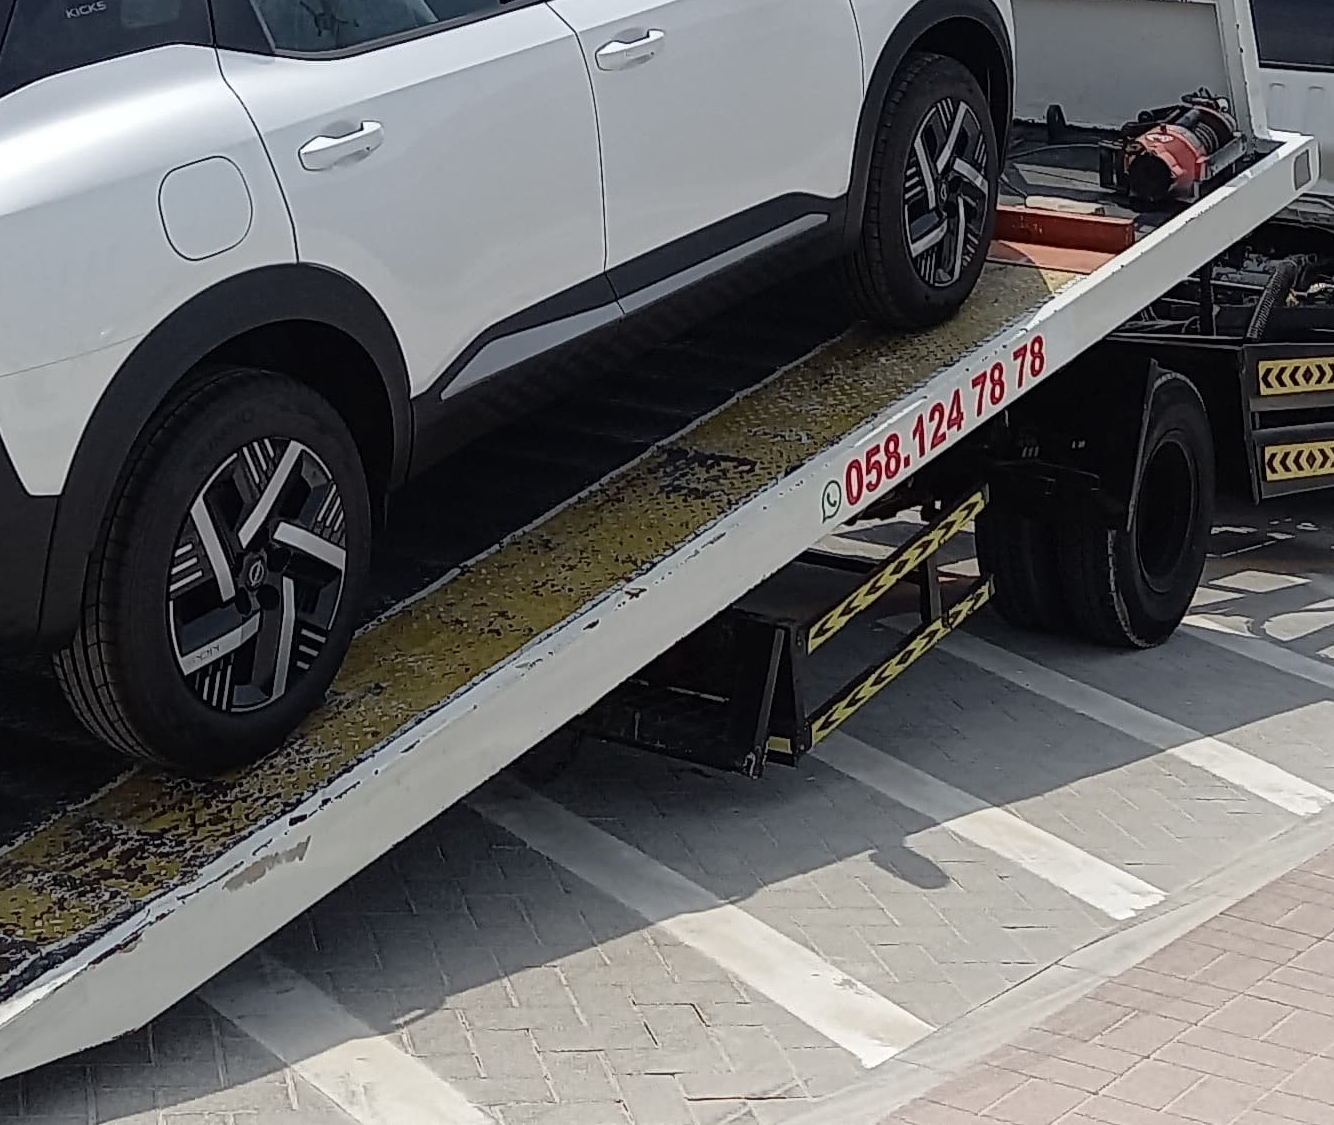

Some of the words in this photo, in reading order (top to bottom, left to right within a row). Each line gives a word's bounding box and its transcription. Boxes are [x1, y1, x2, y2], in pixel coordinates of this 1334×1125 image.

[65, 0, 107, 19] KICKS
[844, 387, 964, 506] 058.124
[971, 361, 1005, 417] 78
[1012, 335, 1046, 389] 78
